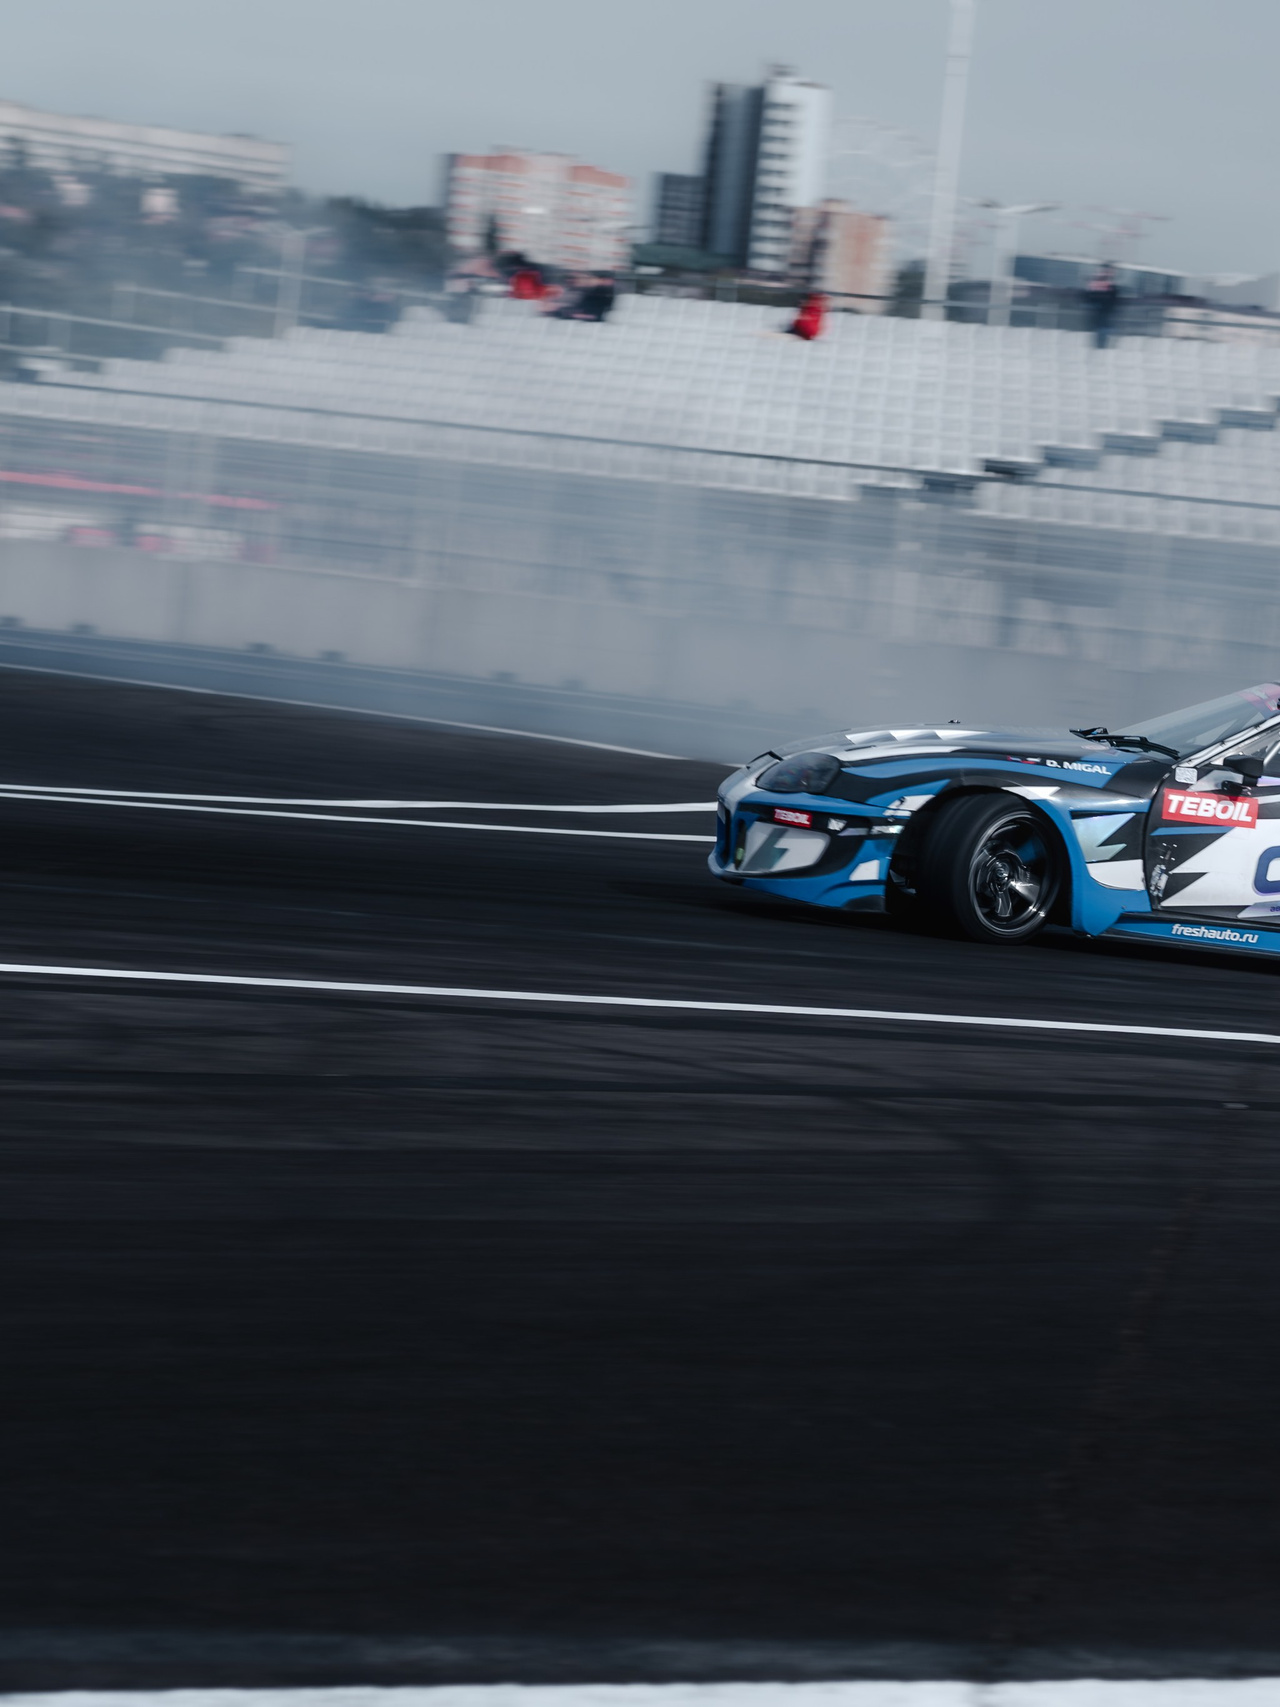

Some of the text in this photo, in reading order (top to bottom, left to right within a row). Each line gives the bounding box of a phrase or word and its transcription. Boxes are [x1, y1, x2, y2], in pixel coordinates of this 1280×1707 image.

[1046, 760, 1112, 776] D. MIGAL
[1167, 794, 1253, 823] TEBOIL
[1171, 923, 1259, 944] freshauto.ru
